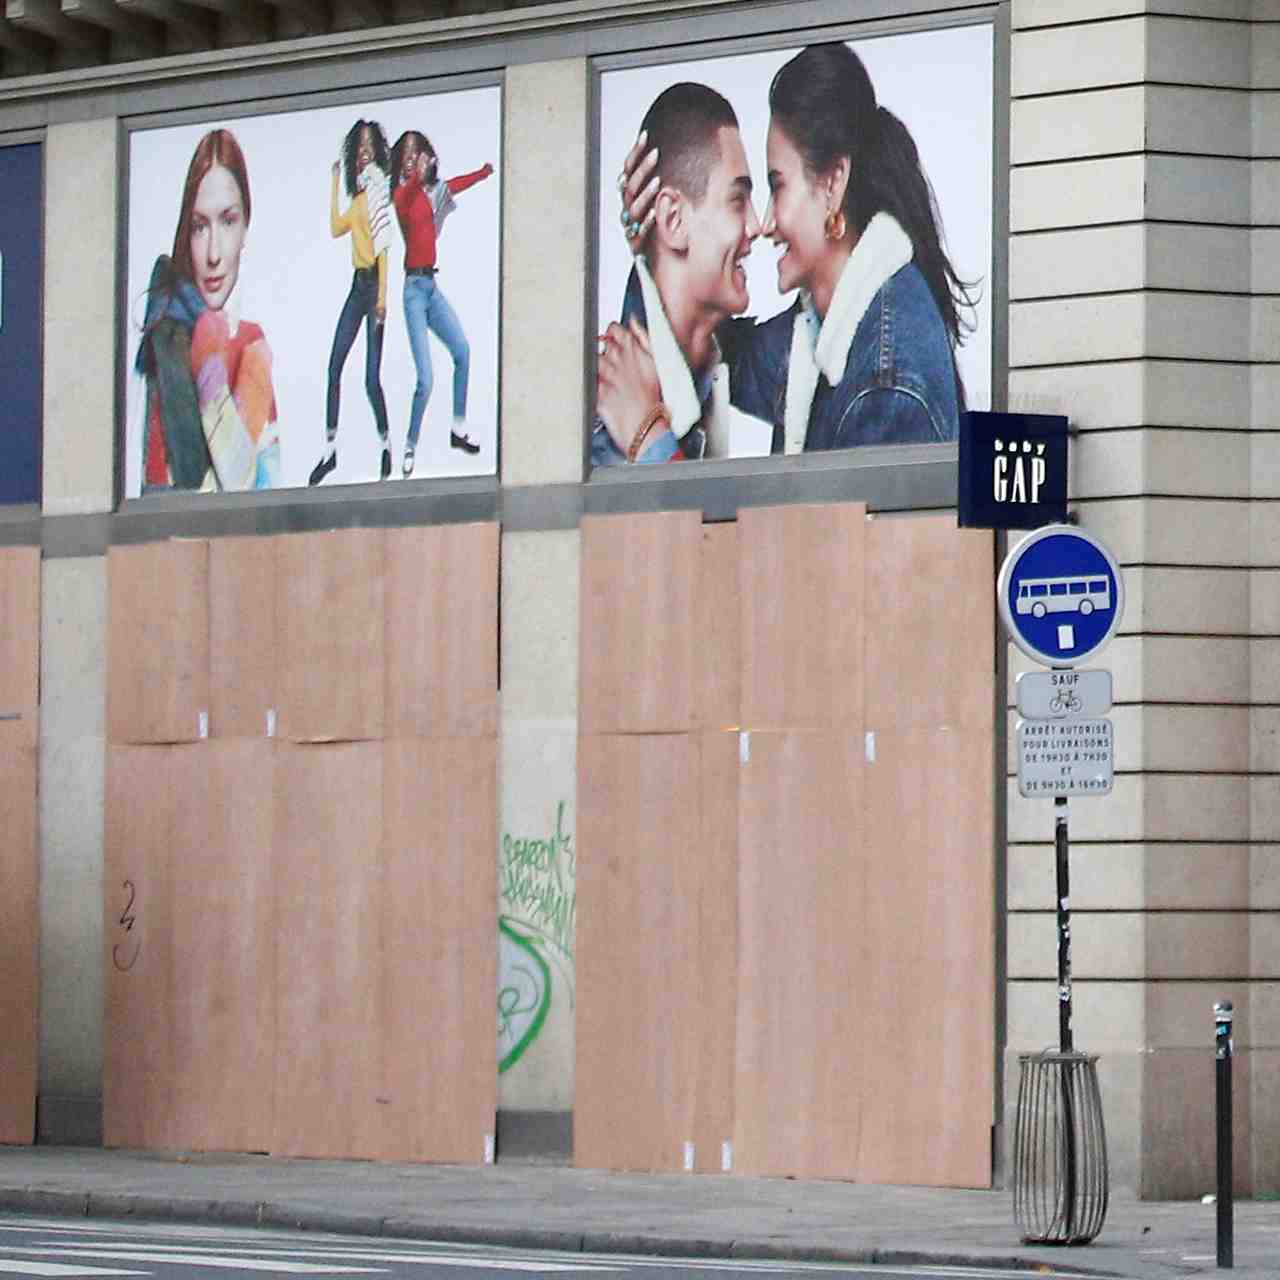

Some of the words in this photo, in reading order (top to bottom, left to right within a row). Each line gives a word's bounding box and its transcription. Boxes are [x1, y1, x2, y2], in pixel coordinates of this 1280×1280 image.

[994, 438, 1046, 456] baby
[993, 455, 1046, 504] GAP
[1051, 674, 1080, 686] SAUF
